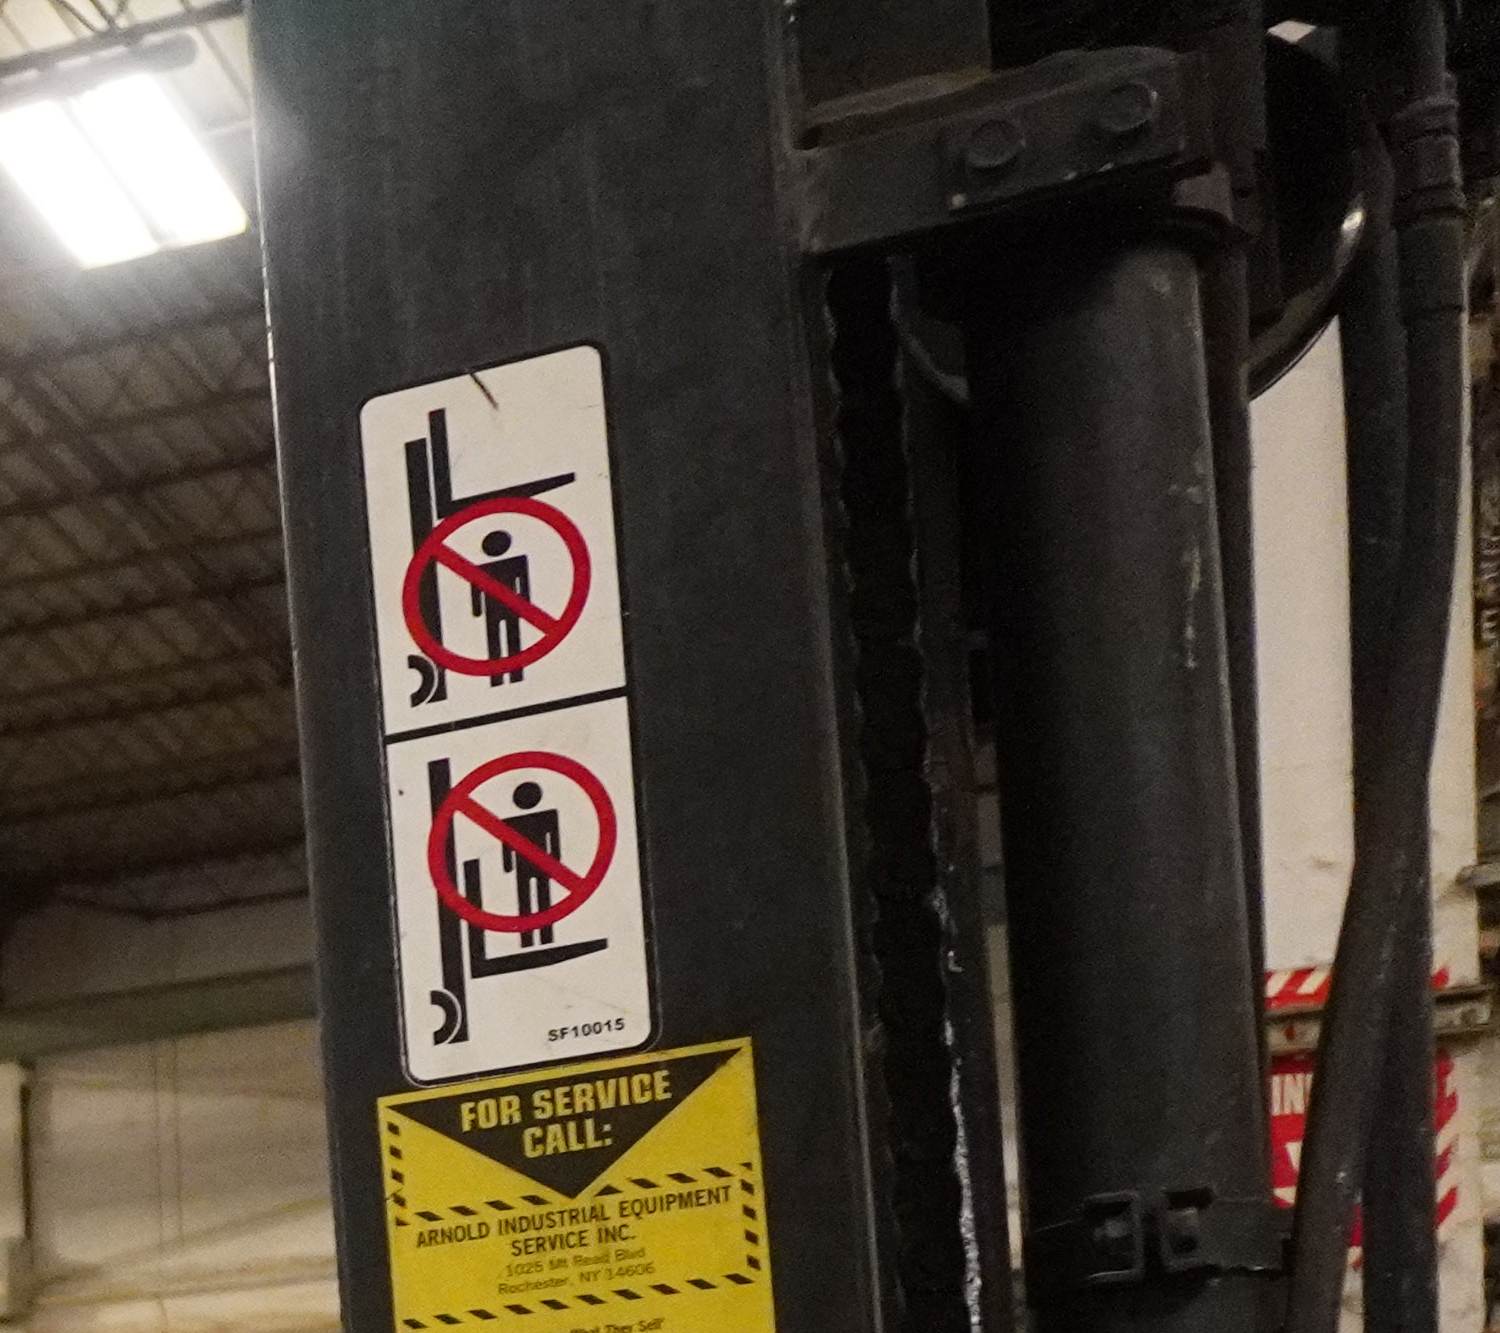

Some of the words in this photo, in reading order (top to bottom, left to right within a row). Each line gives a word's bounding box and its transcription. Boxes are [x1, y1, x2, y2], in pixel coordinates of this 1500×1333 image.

[547, 1017, 625, 1042] SF10015
[460, 1094, 522, 1133] FOR
[531, 1069, 673, 1120] SERVICE
[522, 1118, 613, 1159] CALL:
[416, 1221, 491, 1249] ARNOLD
[497, 1202, 611, 1236] INDUSTRIAL
[618, 1185, 732, 1220] EQUIPMENT
[511, 1229, 590, 1257] SERVICE
[597, 1223, 637, 1244] INC.
[579, 1267, 601, 1284] NY
